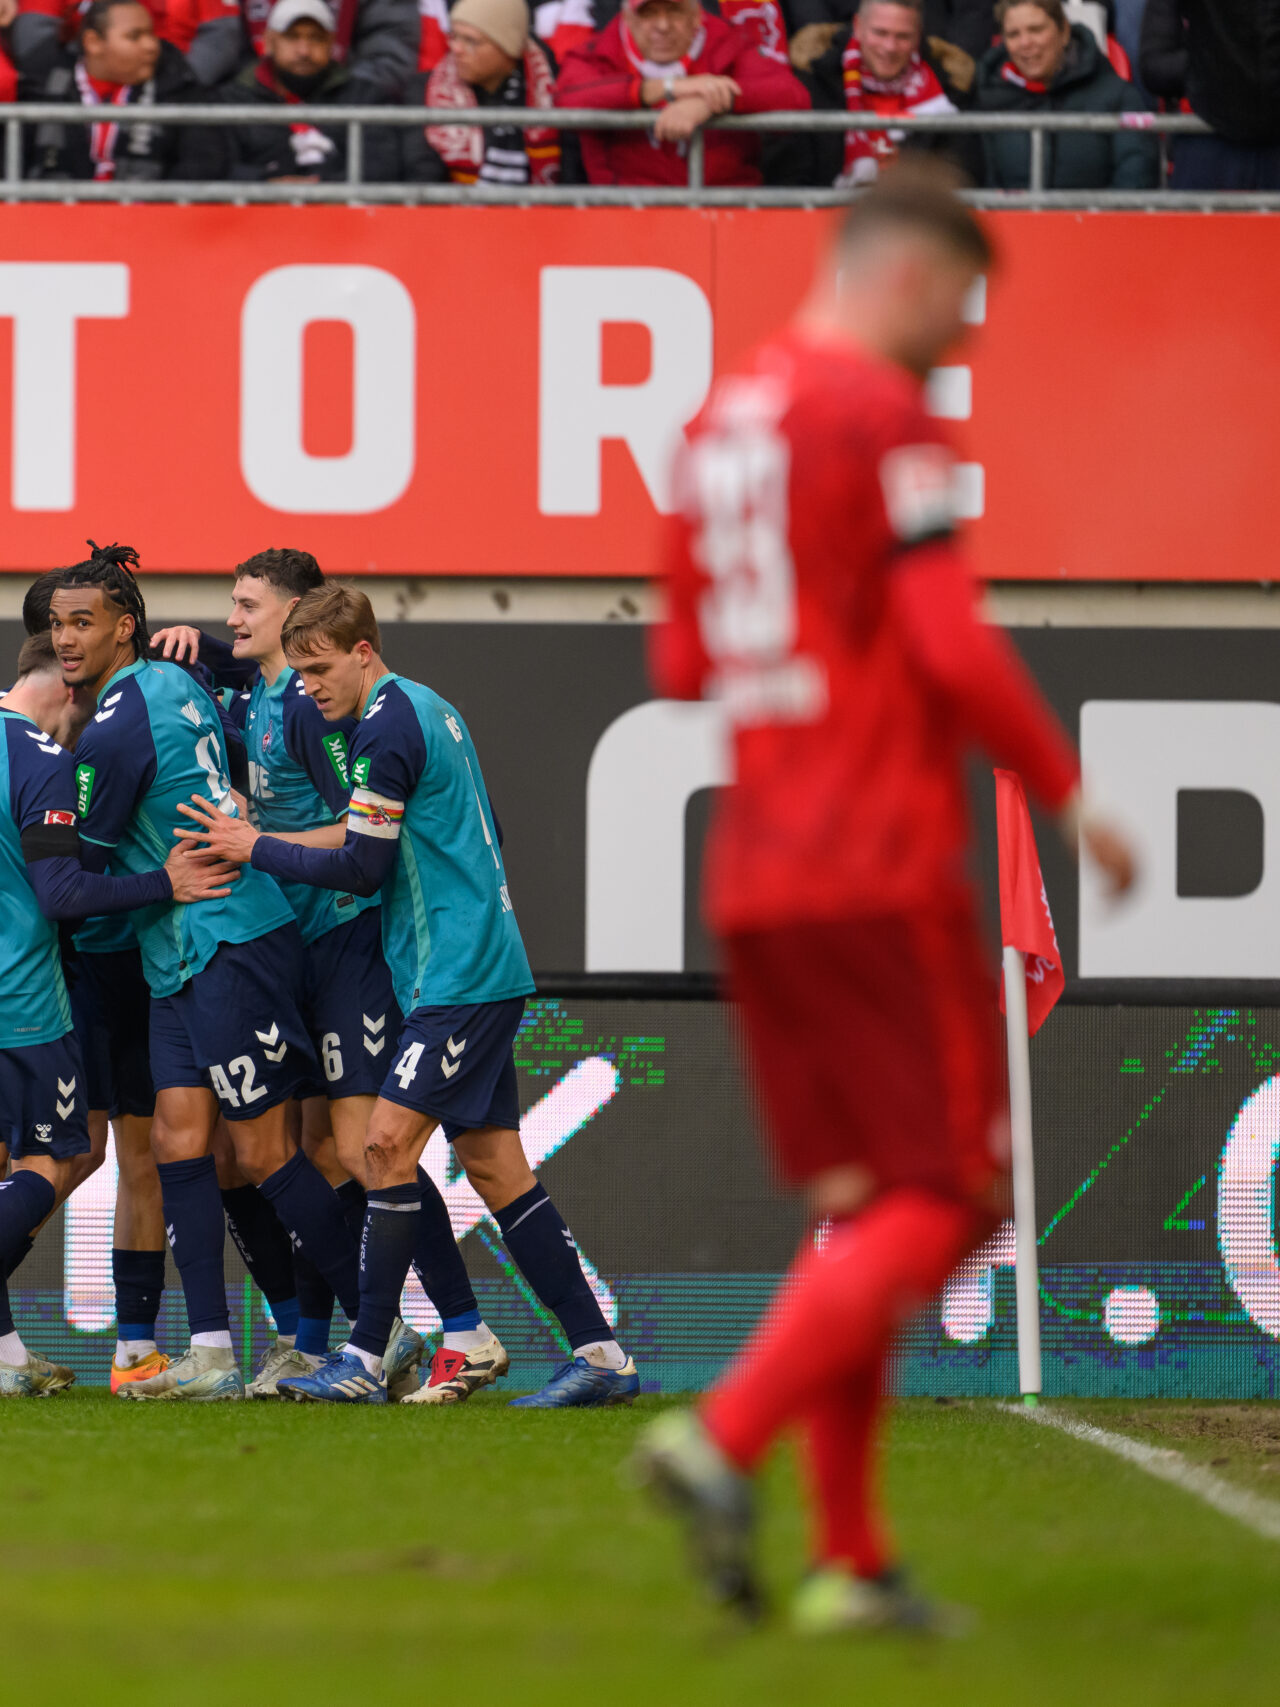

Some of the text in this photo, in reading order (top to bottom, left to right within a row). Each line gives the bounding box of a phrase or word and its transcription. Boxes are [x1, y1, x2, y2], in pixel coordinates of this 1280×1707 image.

[78, 770, 91, 813] DEVK
[209, 1055, 268, 1107] 42
[322, 1032, 344, 1082] 6
[394, 1042, 425, 1090] 4
